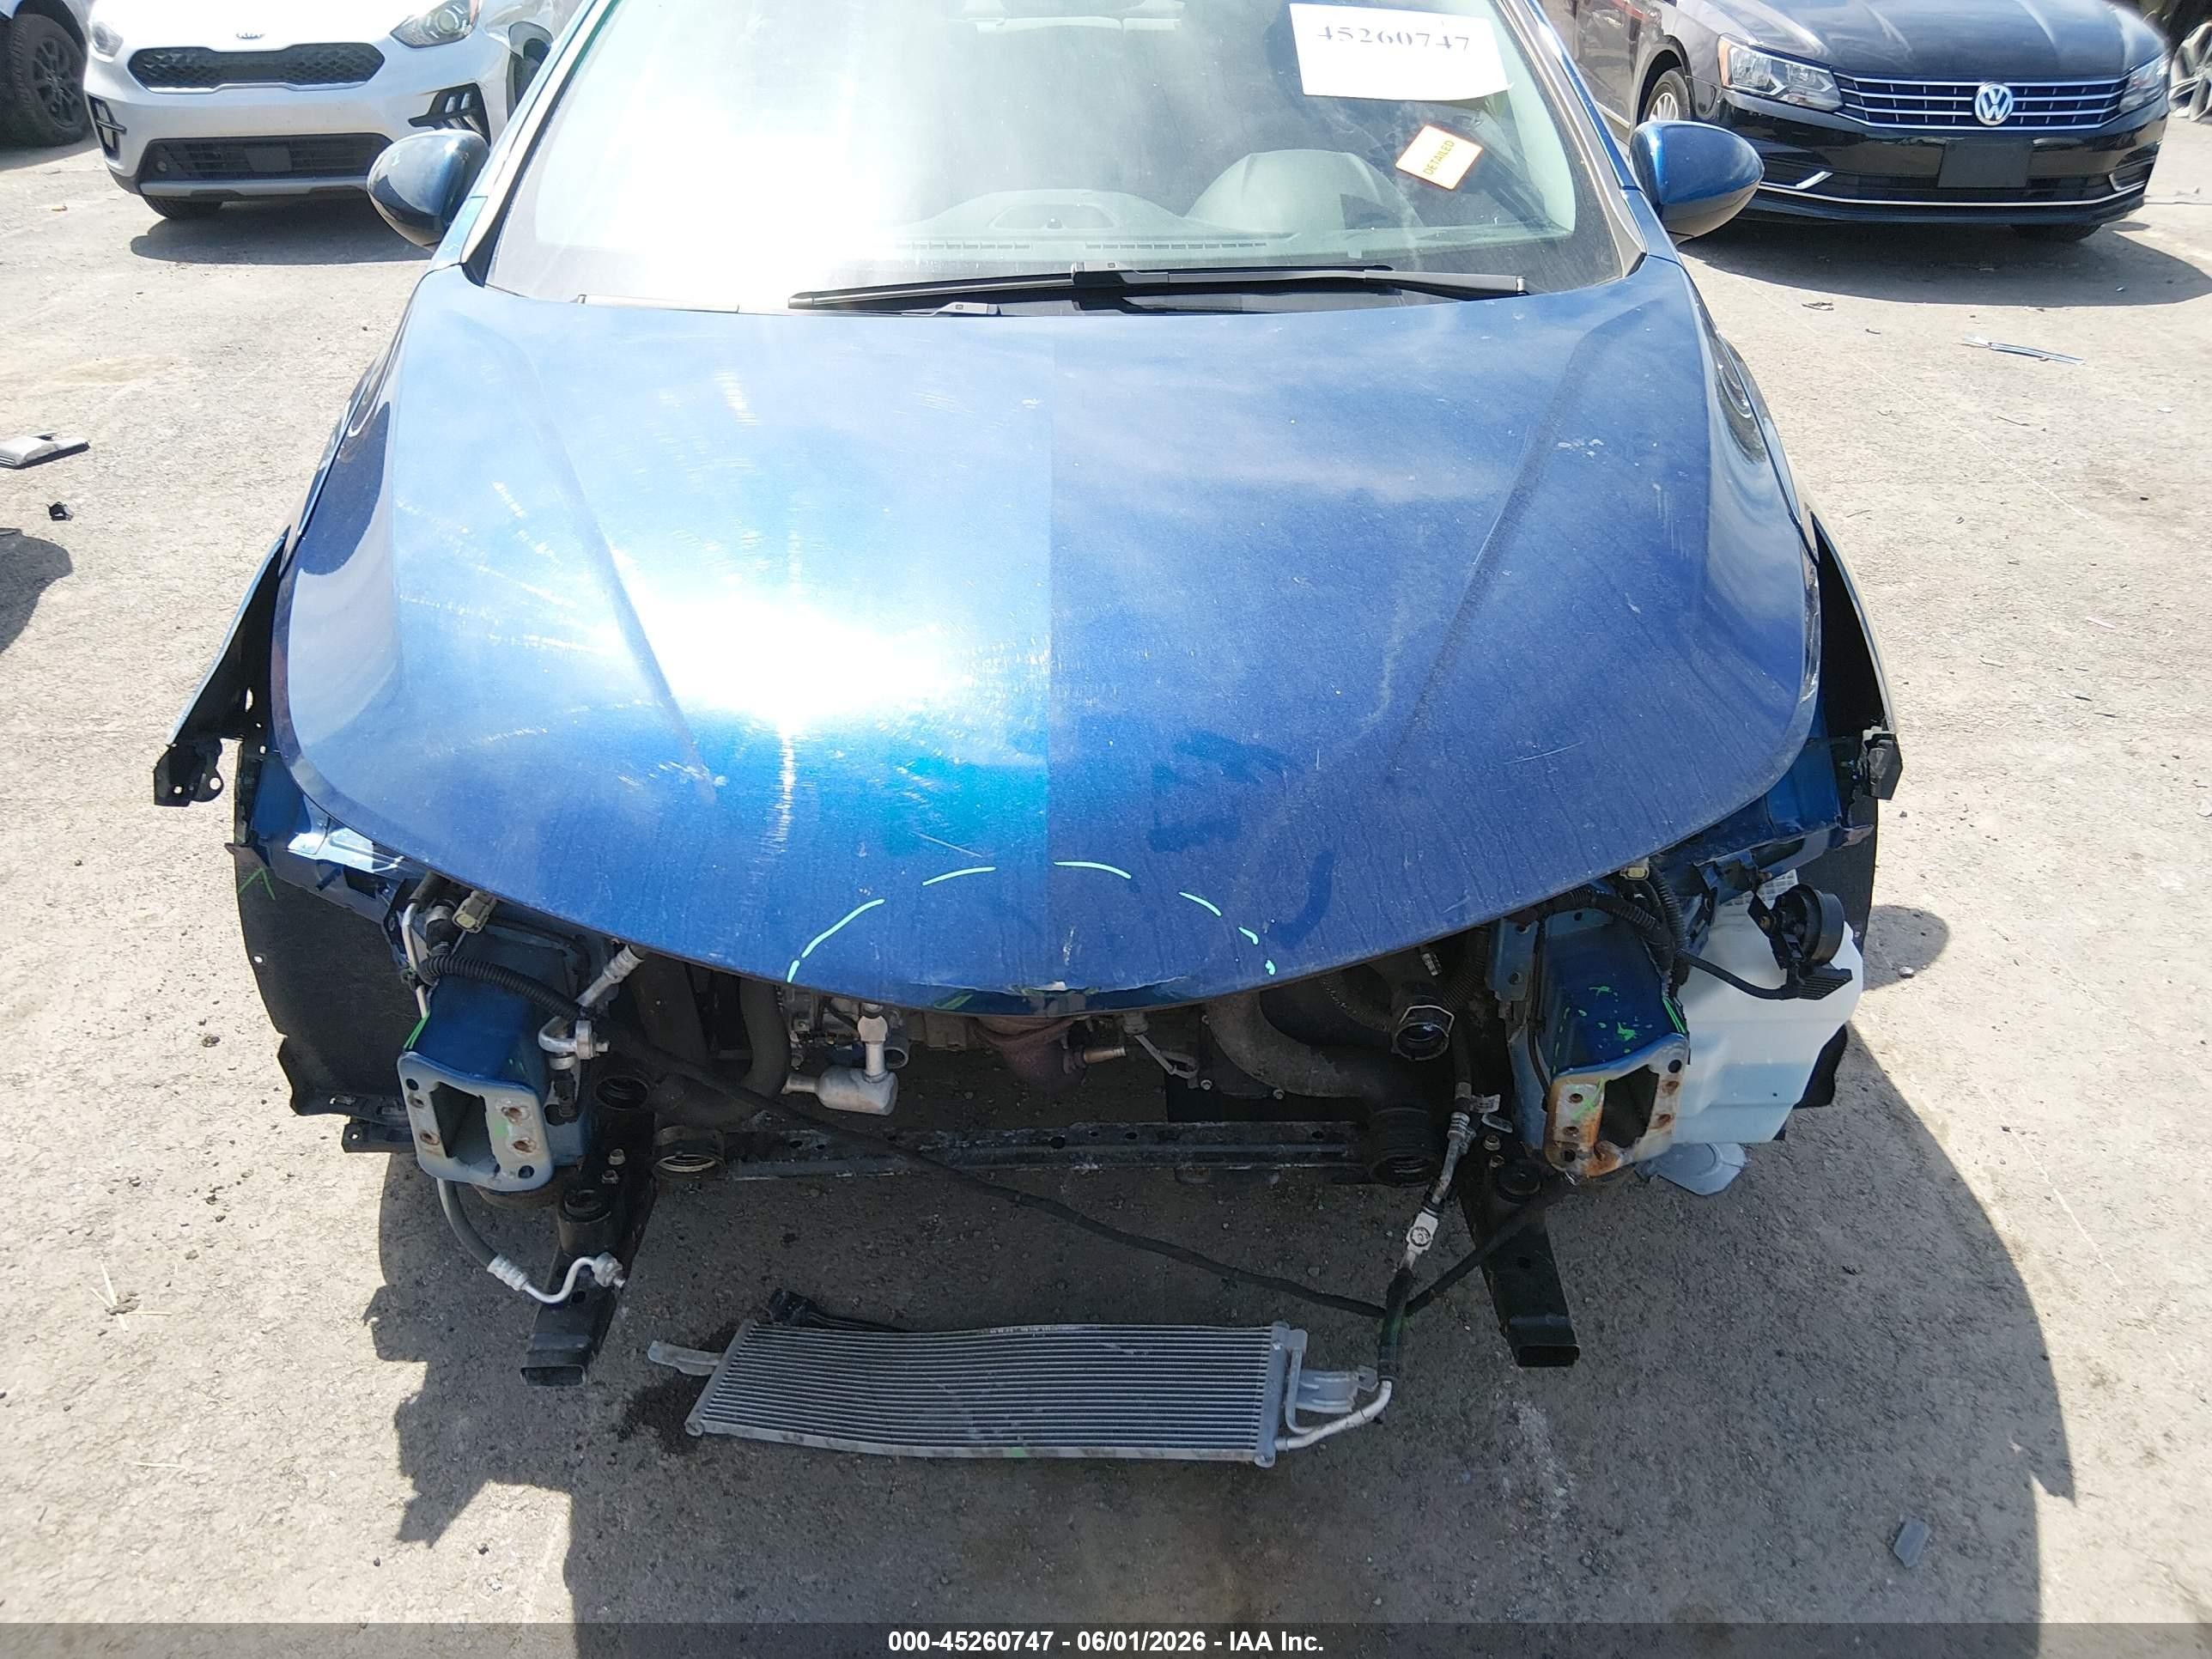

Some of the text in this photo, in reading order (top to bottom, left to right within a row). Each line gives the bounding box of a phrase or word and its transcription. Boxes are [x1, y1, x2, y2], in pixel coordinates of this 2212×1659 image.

[1317, 22, 1470, 51] 45260747
[1976, 83, 2013, 125] VW
[1423, 139, 1455, 175] DETAILED
